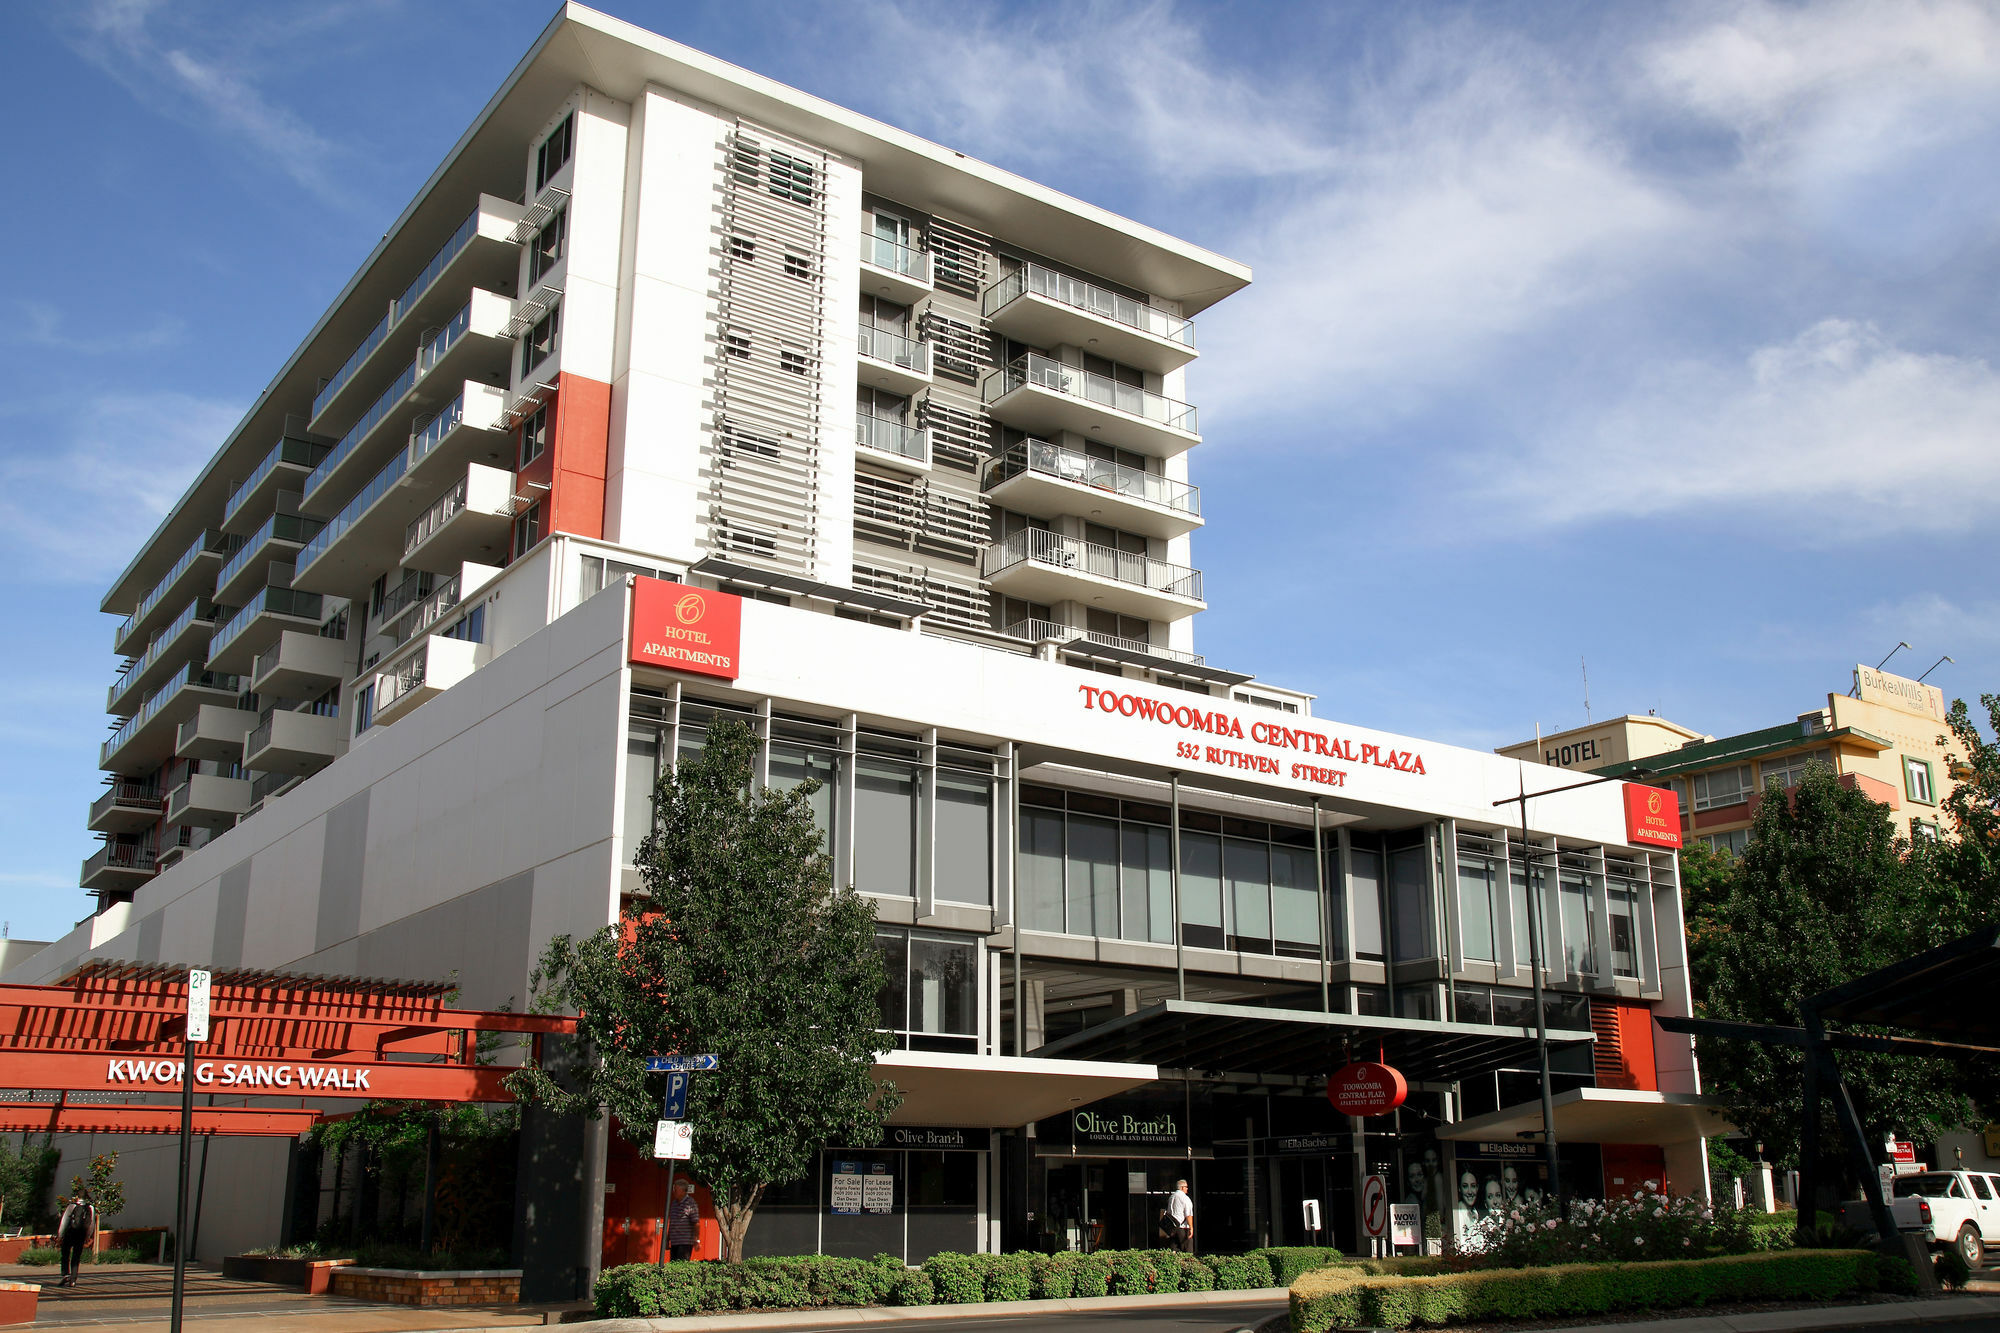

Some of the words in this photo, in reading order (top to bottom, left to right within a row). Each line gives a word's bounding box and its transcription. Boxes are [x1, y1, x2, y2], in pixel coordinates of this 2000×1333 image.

[665, 626, 712, 645] HOTEL
[642, 642, 731, 668] APARTMENTS
[1907, 700, 1924, 711] Hotel
[1078, 684, 1245, 740] TOOWOOMBA
[1251, 721, 1359, 762] CENTRAL
[1361, 743, 1427, 775] PLAZA
[1545, 739, 1600, 767] HOTEL
[1176, 741, 1200, 761] 532
[1205, 746, 1280, 775] RUTHVEN
[1291, 763, 1348, 788] STREET
[1645, 816, 1667, 827] HOTEL
[1637, 828, 1678, 842] APARTMENTS
[192, 972, 207, 989] 2P
[220, 1063, 292, 1086] SANG
[297, 1067, 372, 1089] WALK
[671, 1076, 683, 1097] P
[1343, 1082, 1381, 1090] TOOWOOMBA
[1075, 1112, 1118, 1133] Olive
[895, 1129, 924, 1142] Olive
[1394, 1213, 1417, 1221] WOW
